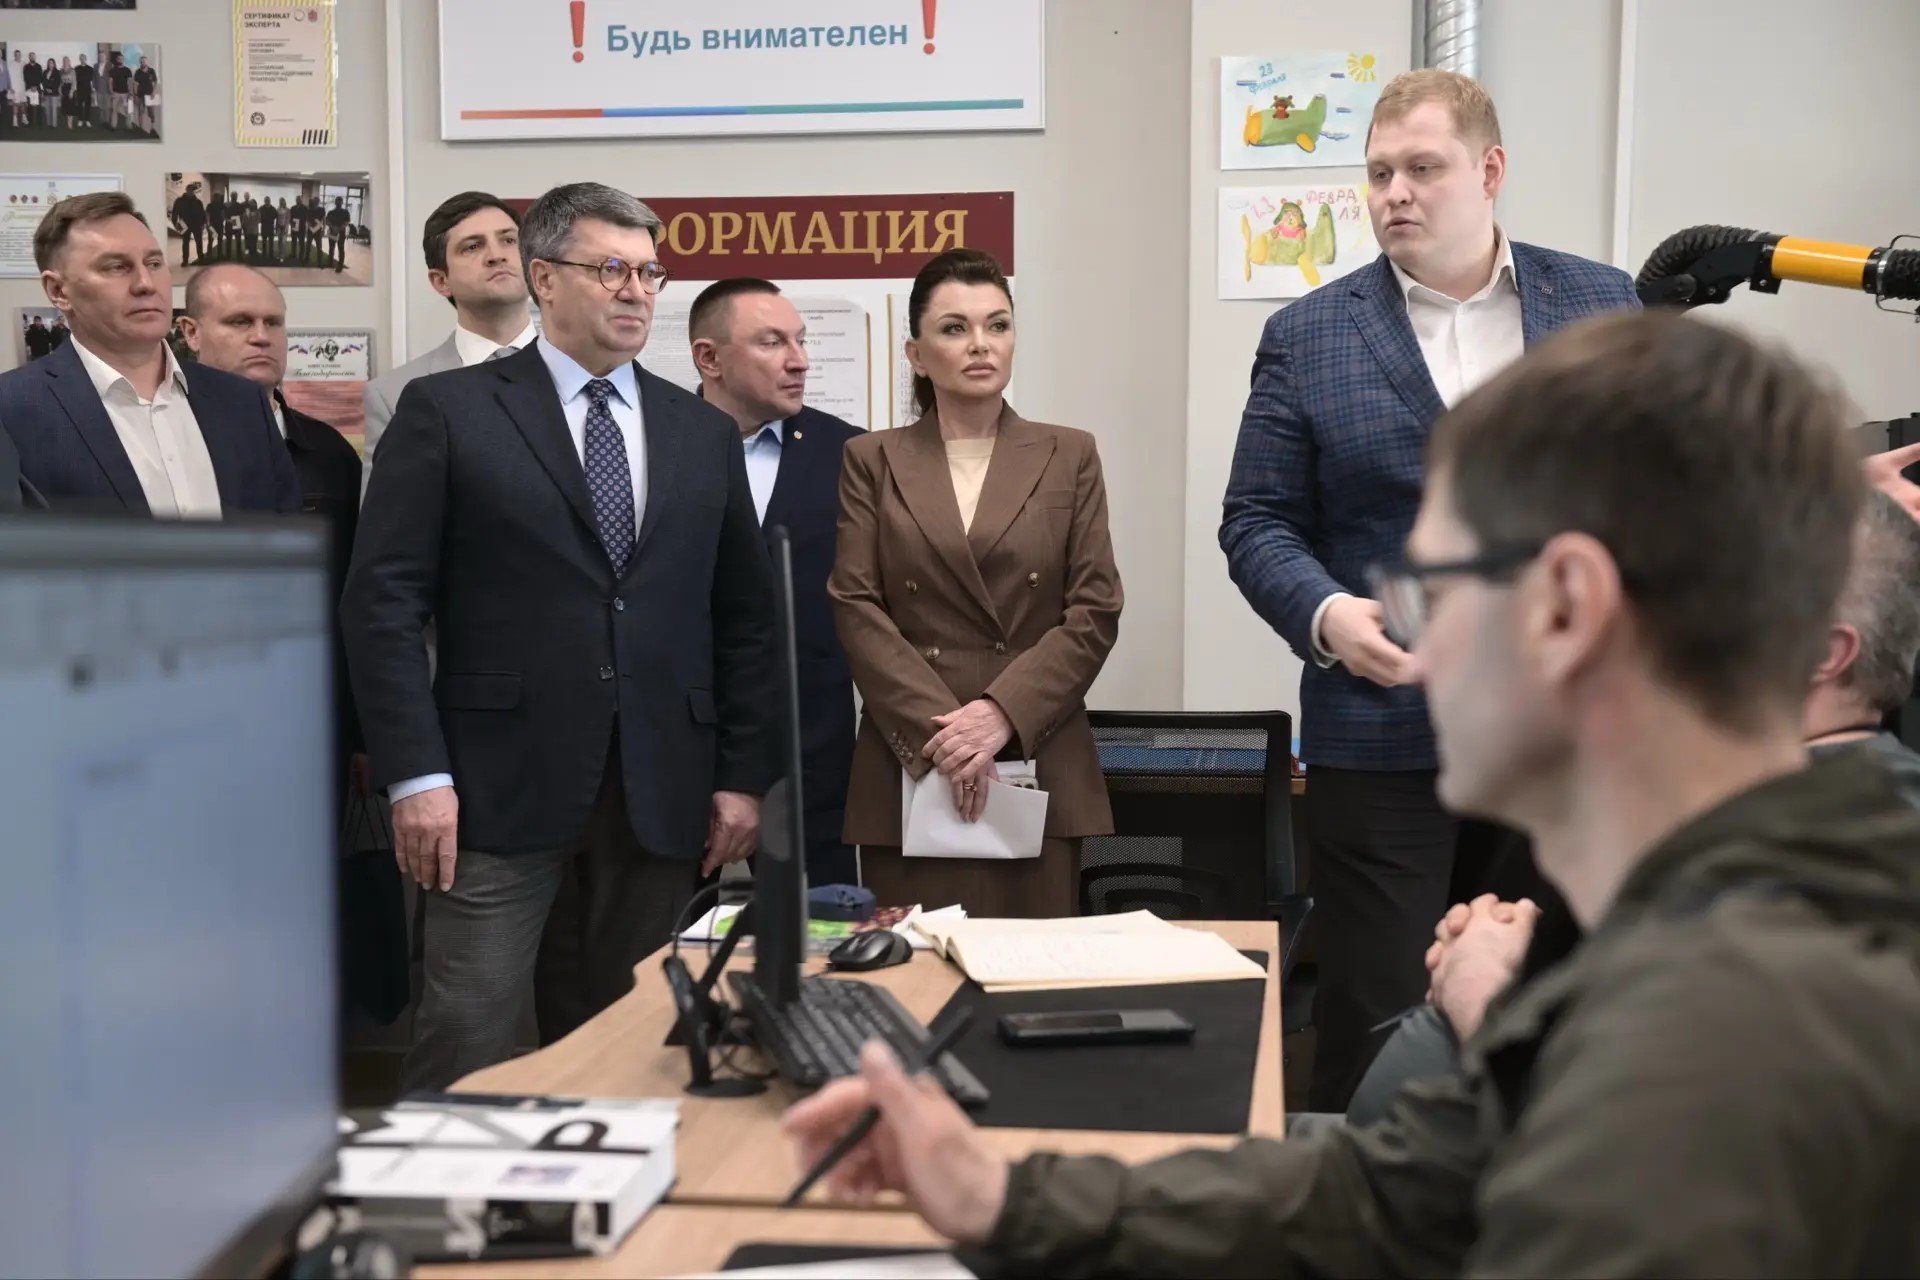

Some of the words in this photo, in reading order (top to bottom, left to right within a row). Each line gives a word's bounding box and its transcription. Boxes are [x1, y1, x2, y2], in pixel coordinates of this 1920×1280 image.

[606, 25, 691, 58] Будь
[702, 23, 908, 52] внимателен
[656, 209, 969, 264] ОРМАЦИЯ
